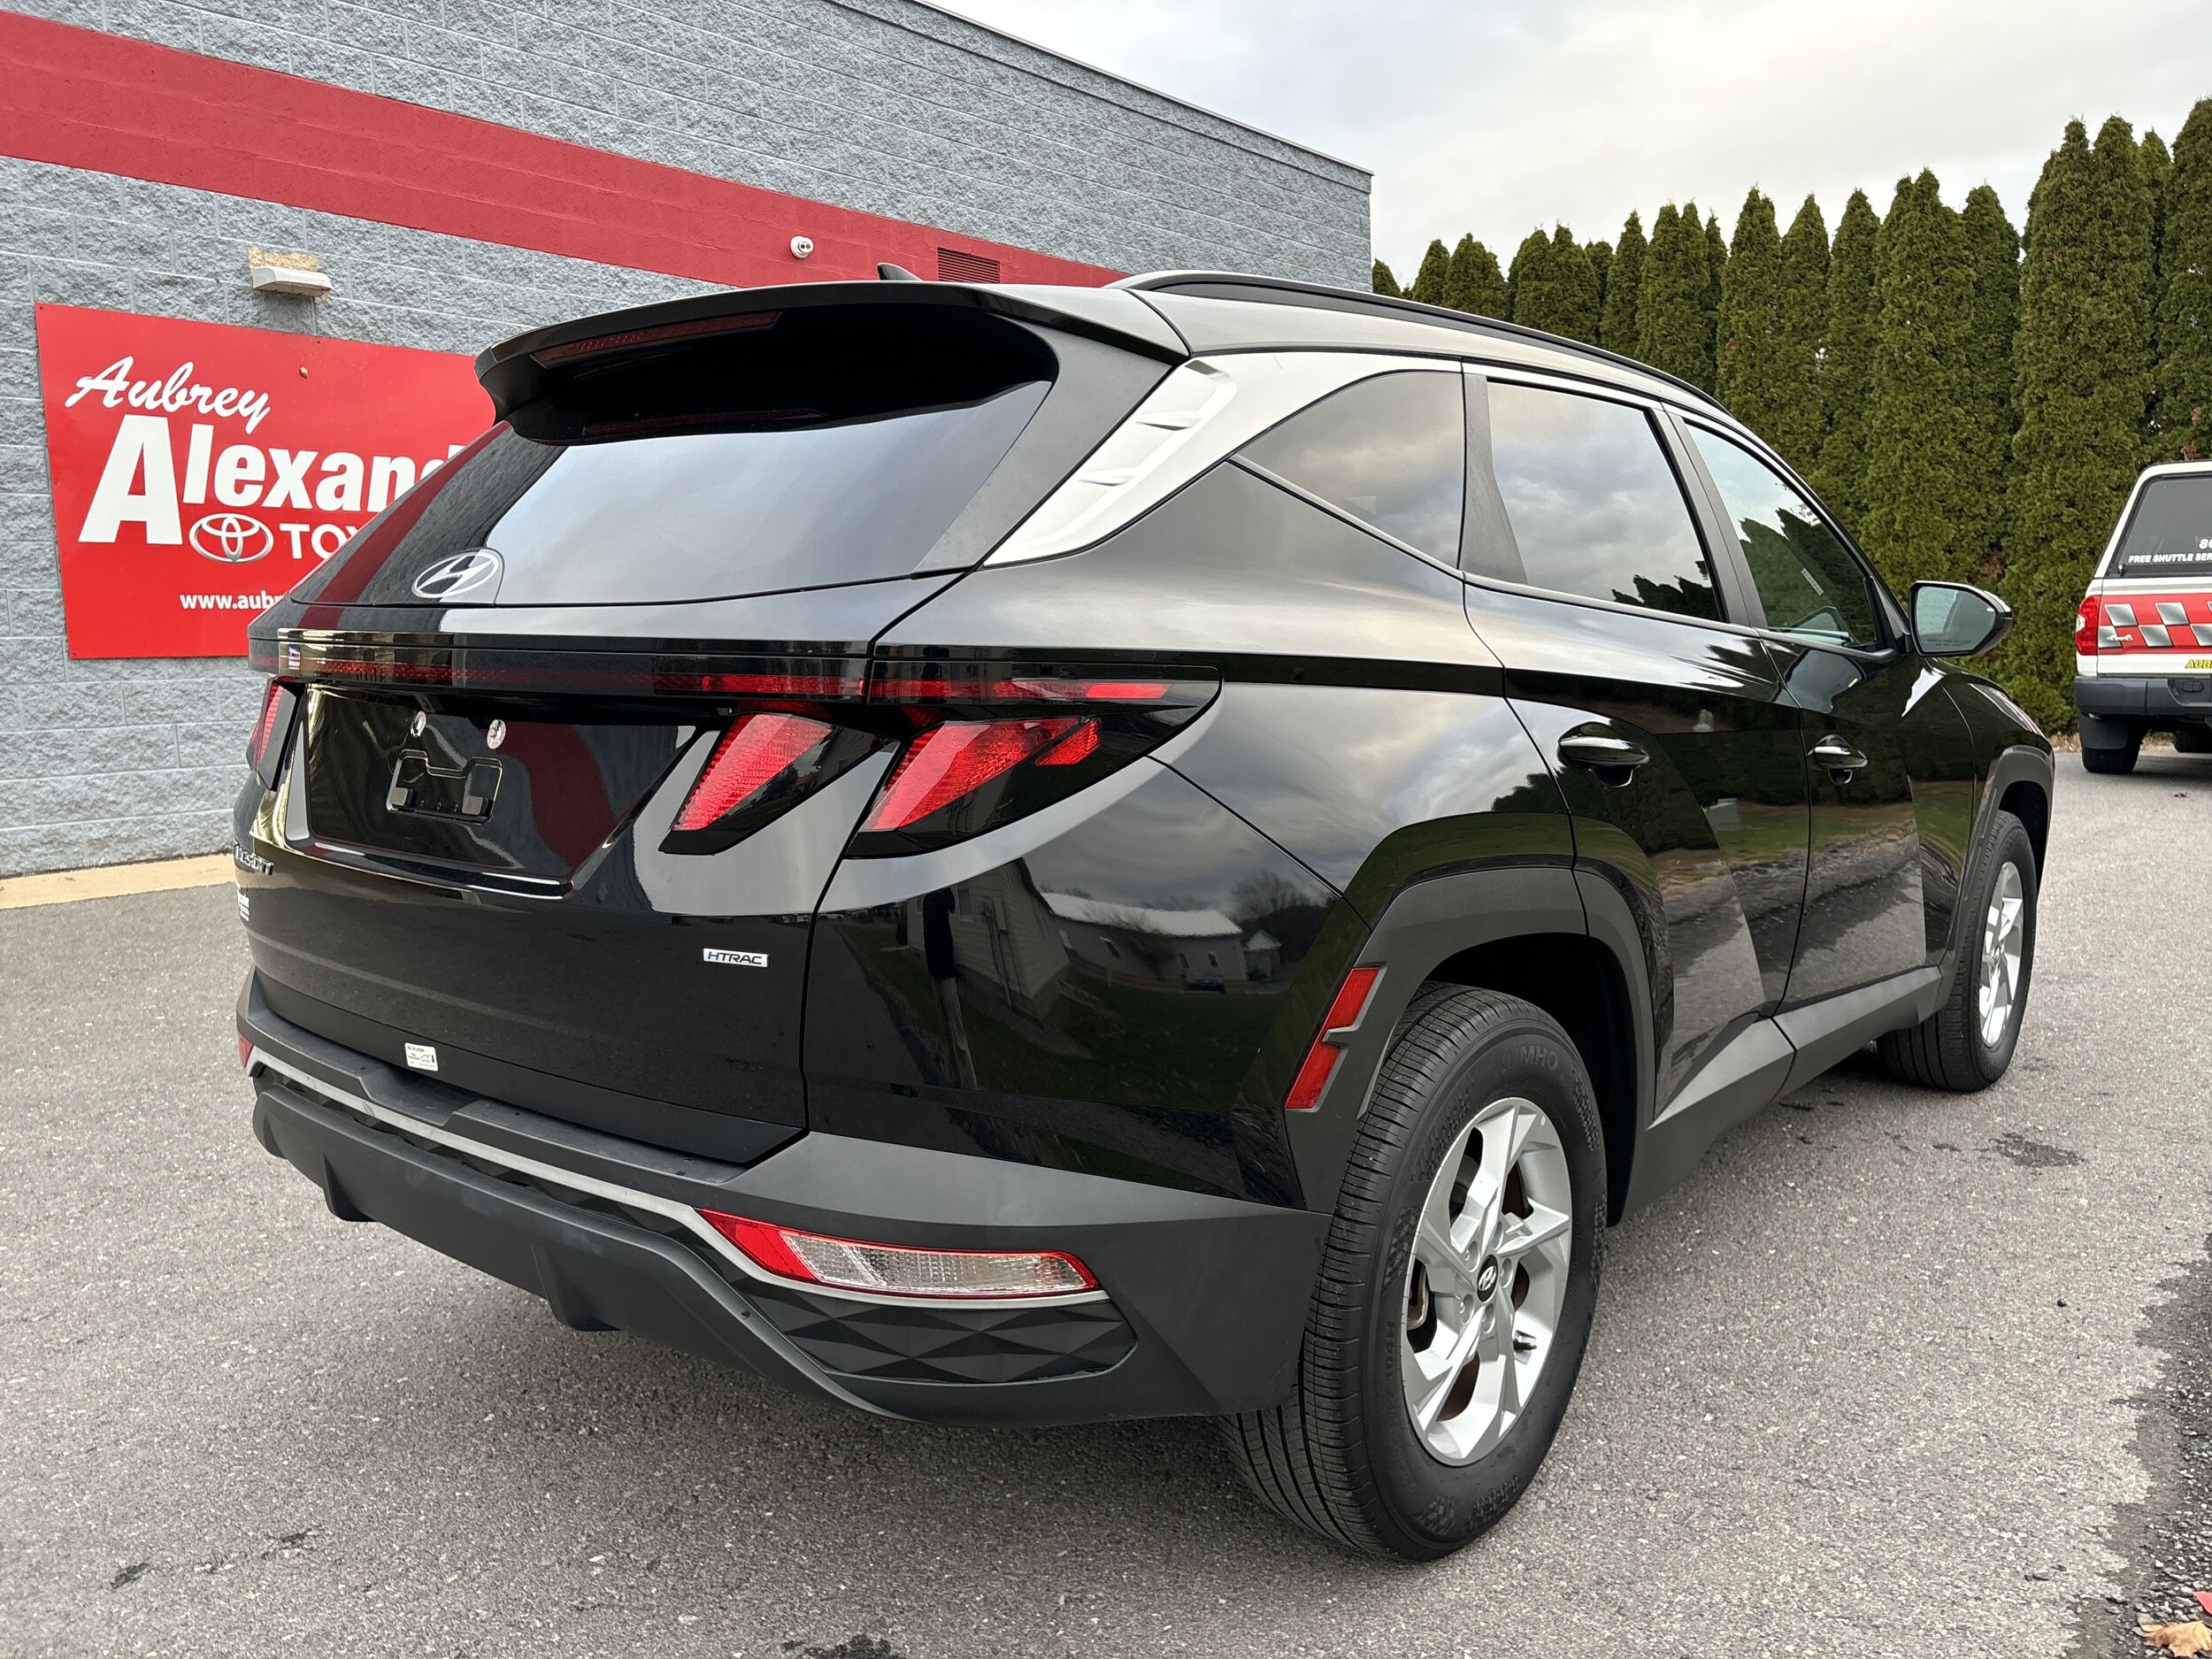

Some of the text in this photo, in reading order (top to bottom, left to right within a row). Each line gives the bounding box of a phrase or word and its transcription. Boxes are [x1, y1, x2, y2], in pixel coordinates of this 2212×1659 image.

[65, 356, 271, 434] Aubrey
[78, 413, 466, 545] Alexan
[280, 523, 358, 559] TO
[2128, 555, 2152, 564] FREE
[2153, 553, 2194, 563] SHUTTLE
[708, 951, 762, 964] HTRAC
